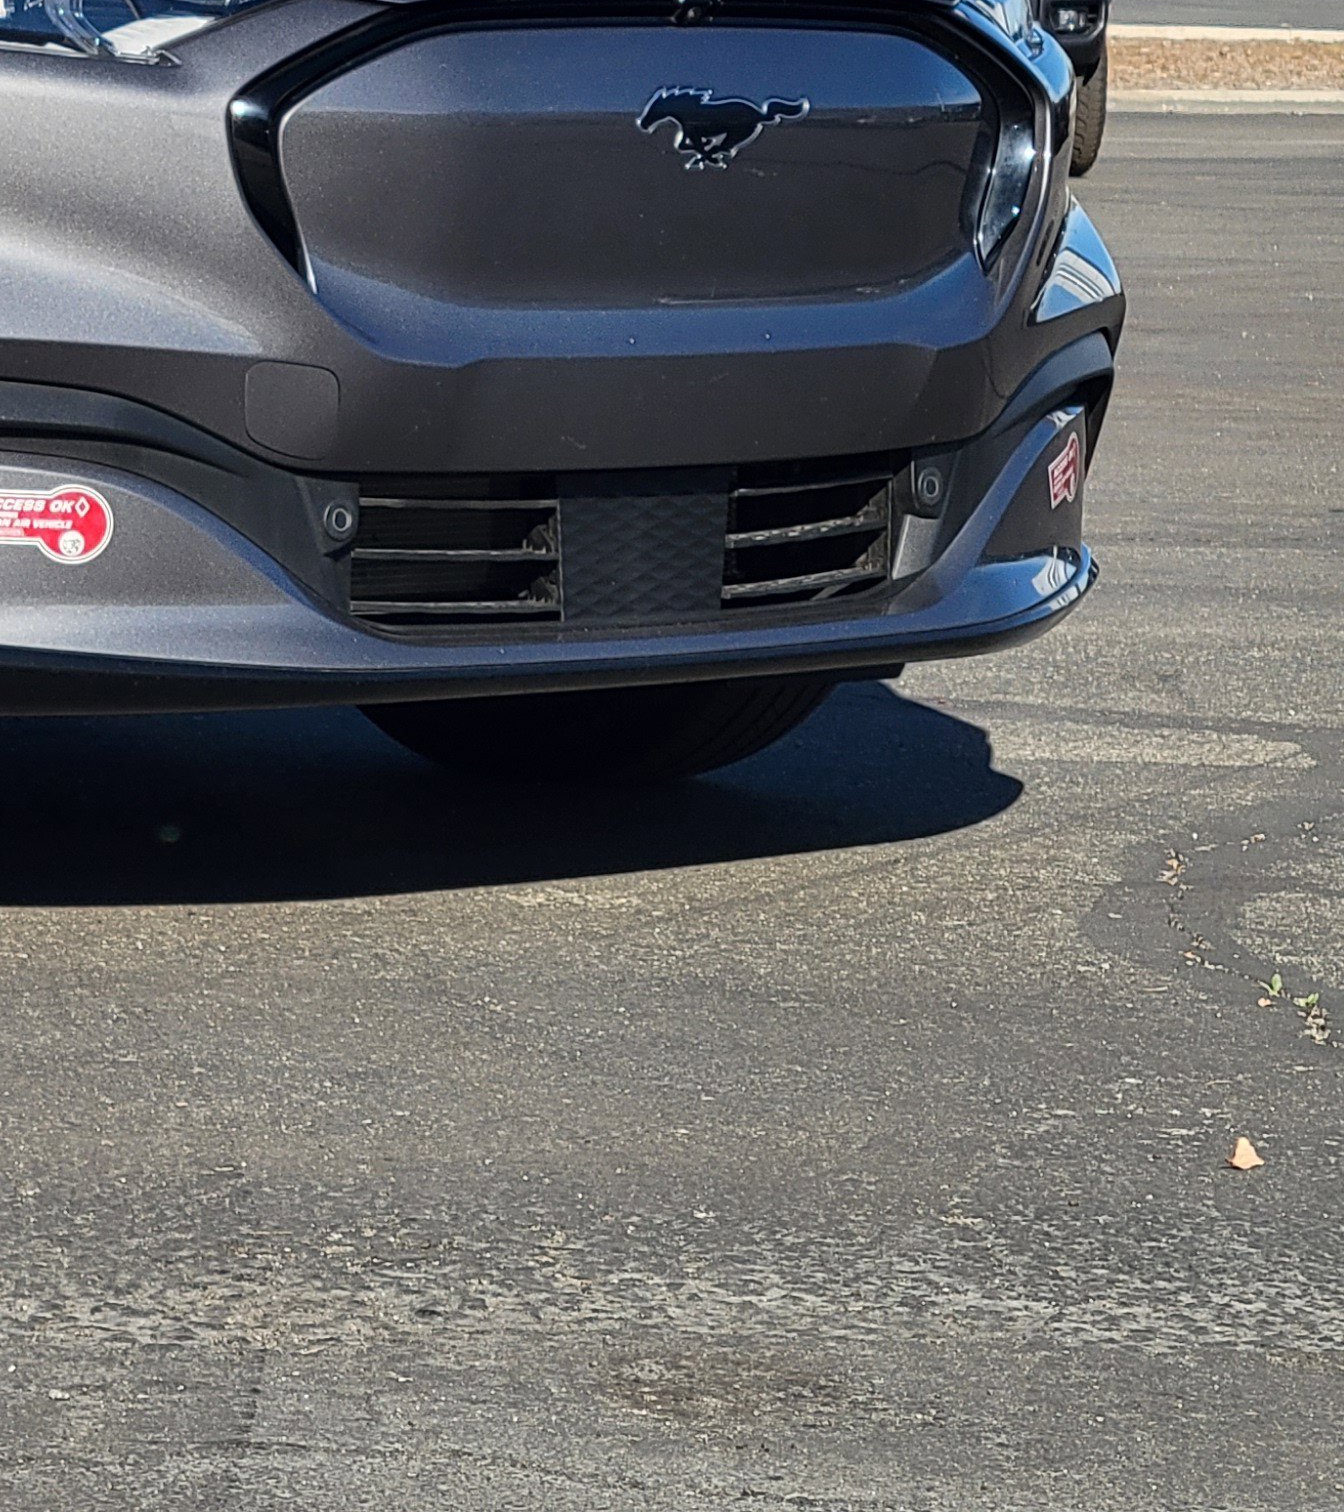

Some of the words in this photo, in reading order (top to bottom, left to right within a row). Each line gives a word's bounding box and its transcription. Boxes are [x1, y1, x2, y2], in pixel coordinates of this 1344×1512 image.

[50, 500, 75, 513] OK
[12, 519, 31, 528] AIR
[33, 520, 73, 529] VEHICLE
